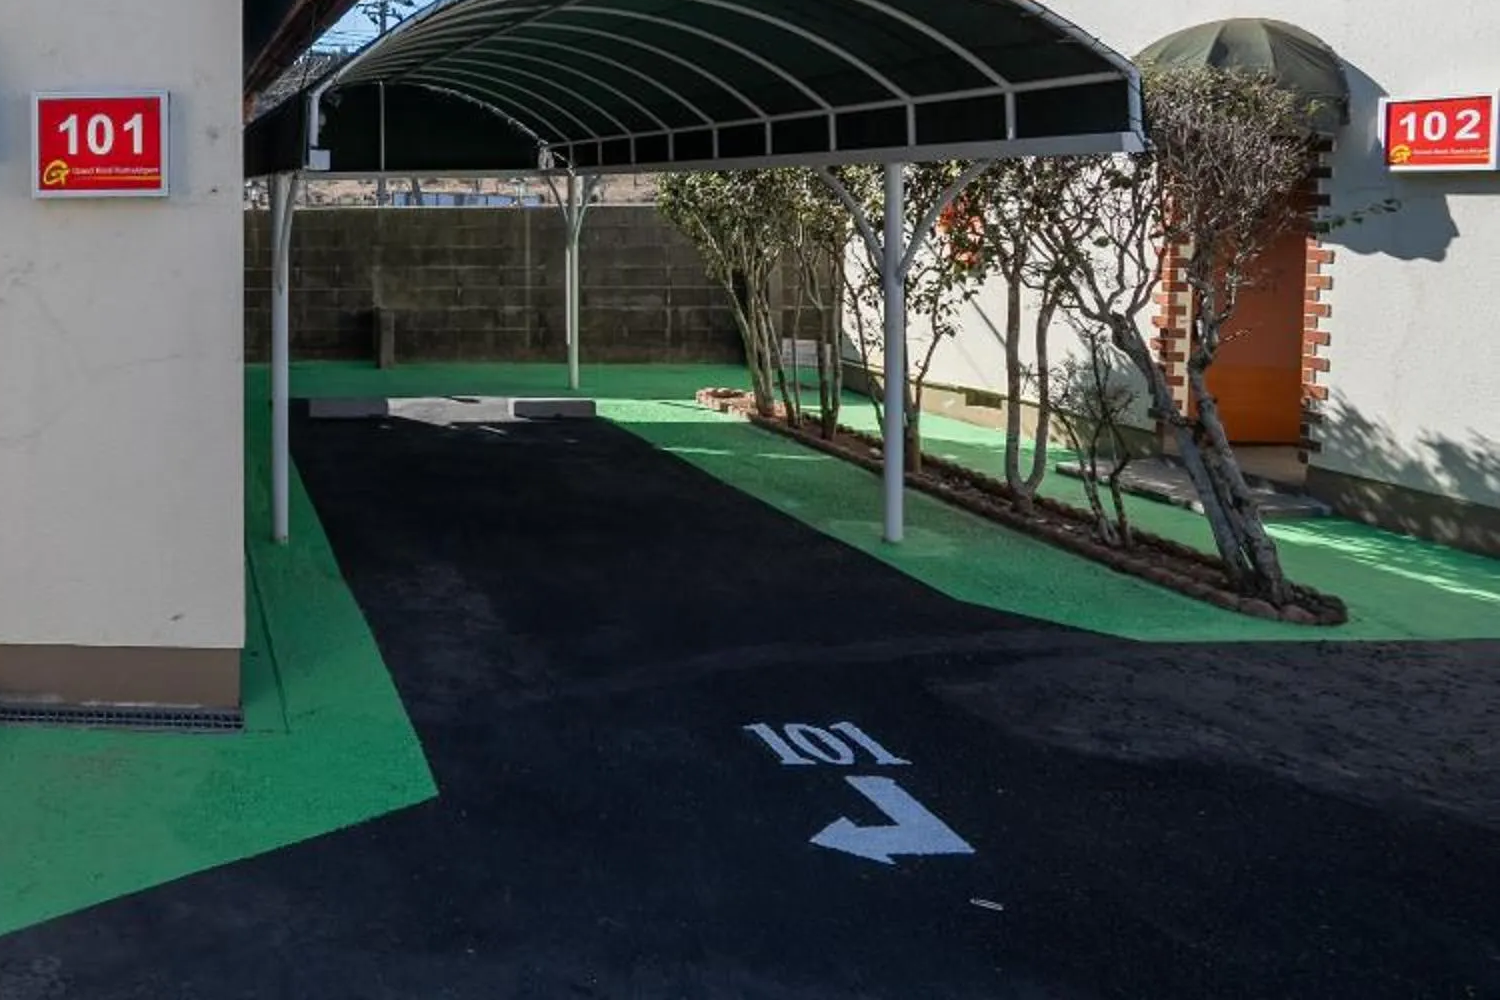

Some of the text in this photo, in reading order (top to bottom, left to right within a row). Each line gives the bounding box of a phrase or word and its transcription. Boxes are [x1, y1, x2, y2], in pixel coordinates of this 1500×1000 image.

[57, 112, 144, 156] 101
[1398, 108, 1481, 142] 102
[743, 720, 913, 765] 101
